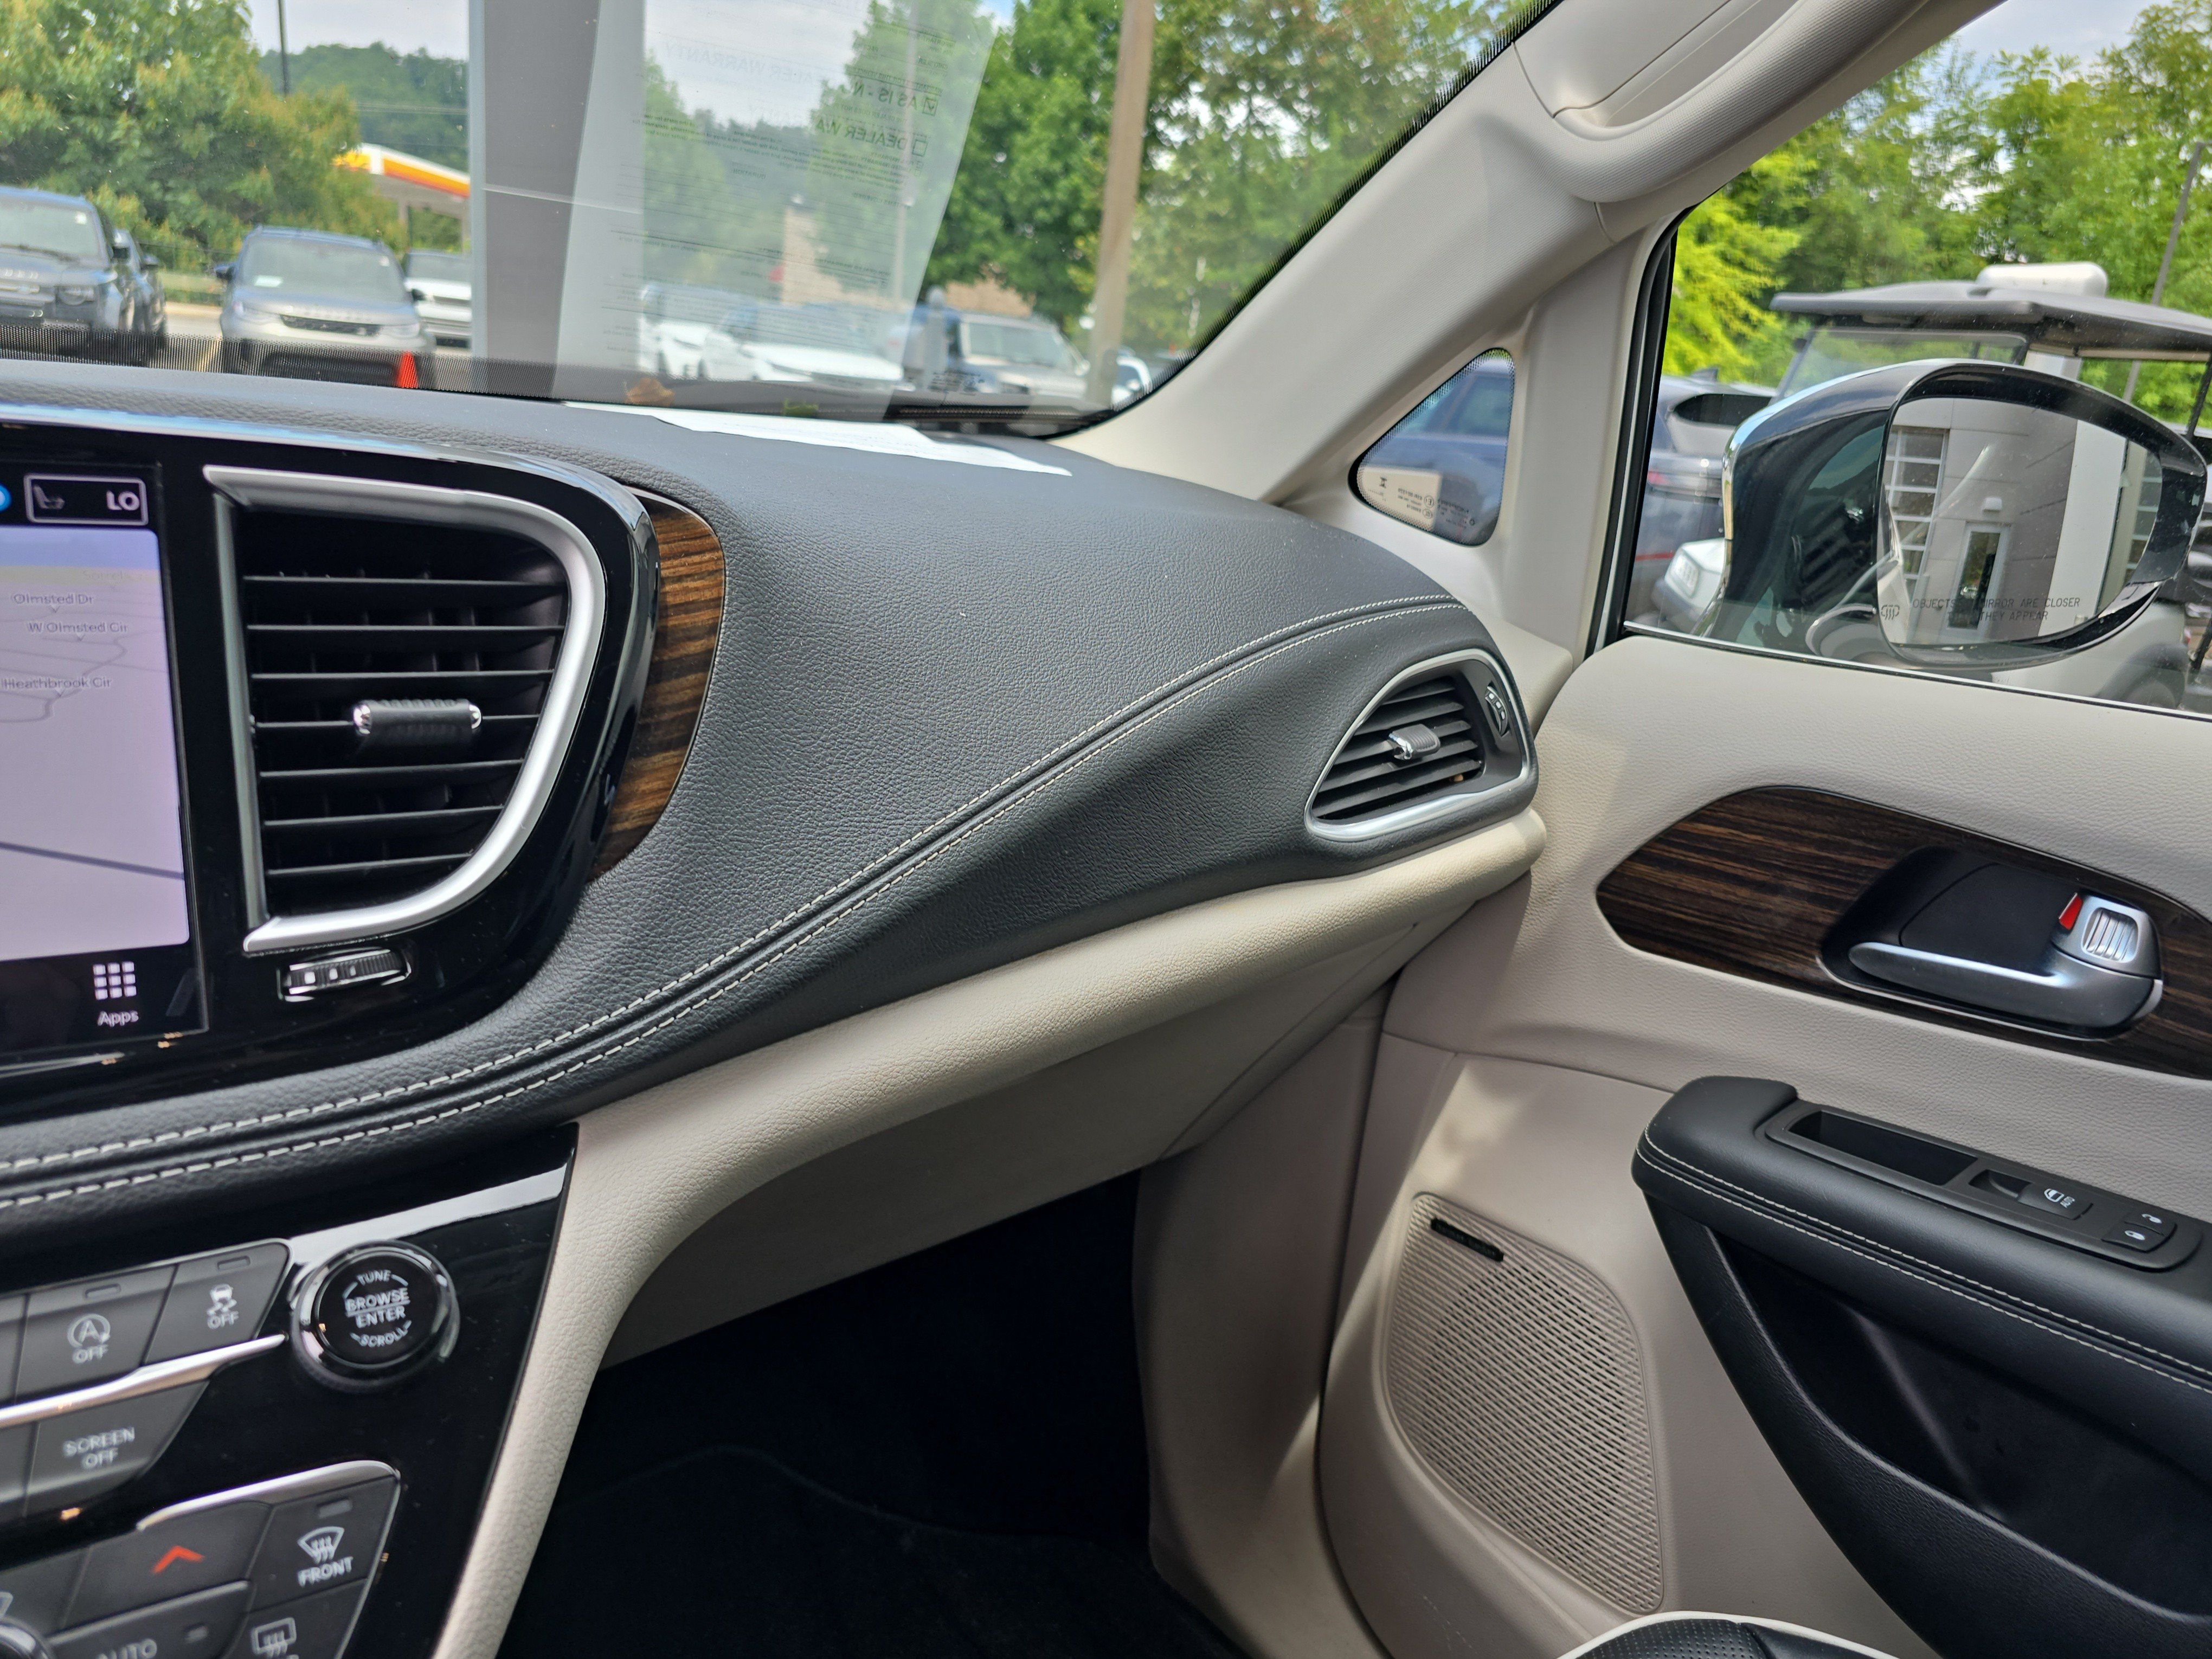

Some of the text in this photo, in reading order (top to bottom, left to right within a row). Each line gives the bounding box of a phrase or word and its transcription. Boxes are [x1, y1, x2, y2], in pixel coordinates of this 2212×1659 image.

[107, 491, 140, 511] LO
[13, 594, 94, 605] Olmsted Dr
[2020, 597, 2039, 608] ARE
[2044, 597, 2080, 608] CLOSER
[1979, 610, 2005, 622] THEY
[2008, 610, 2049, 622] APPEAR
[28, 622, 127, 633] W Olmsted Cir
[93, 678, 112, 688] Cir
[97, 1010, 139, 1027] Apps
[357, 1269, 391, 1285] TUNE
[345, 1287, 409, 1312] BROWSE
[207, 1311, 240, 1330] OFF
[355, 1305, 406, 1329] ENTER
[358, 1324, 409, 1348] SCROLL
[72, 1344, 108, 1364] OFF
[63, 1426, 136, 1458] SCREEN
[81, 1446, 119, 1470] OFF
[298, 1556, 353, 1588] FRONT
